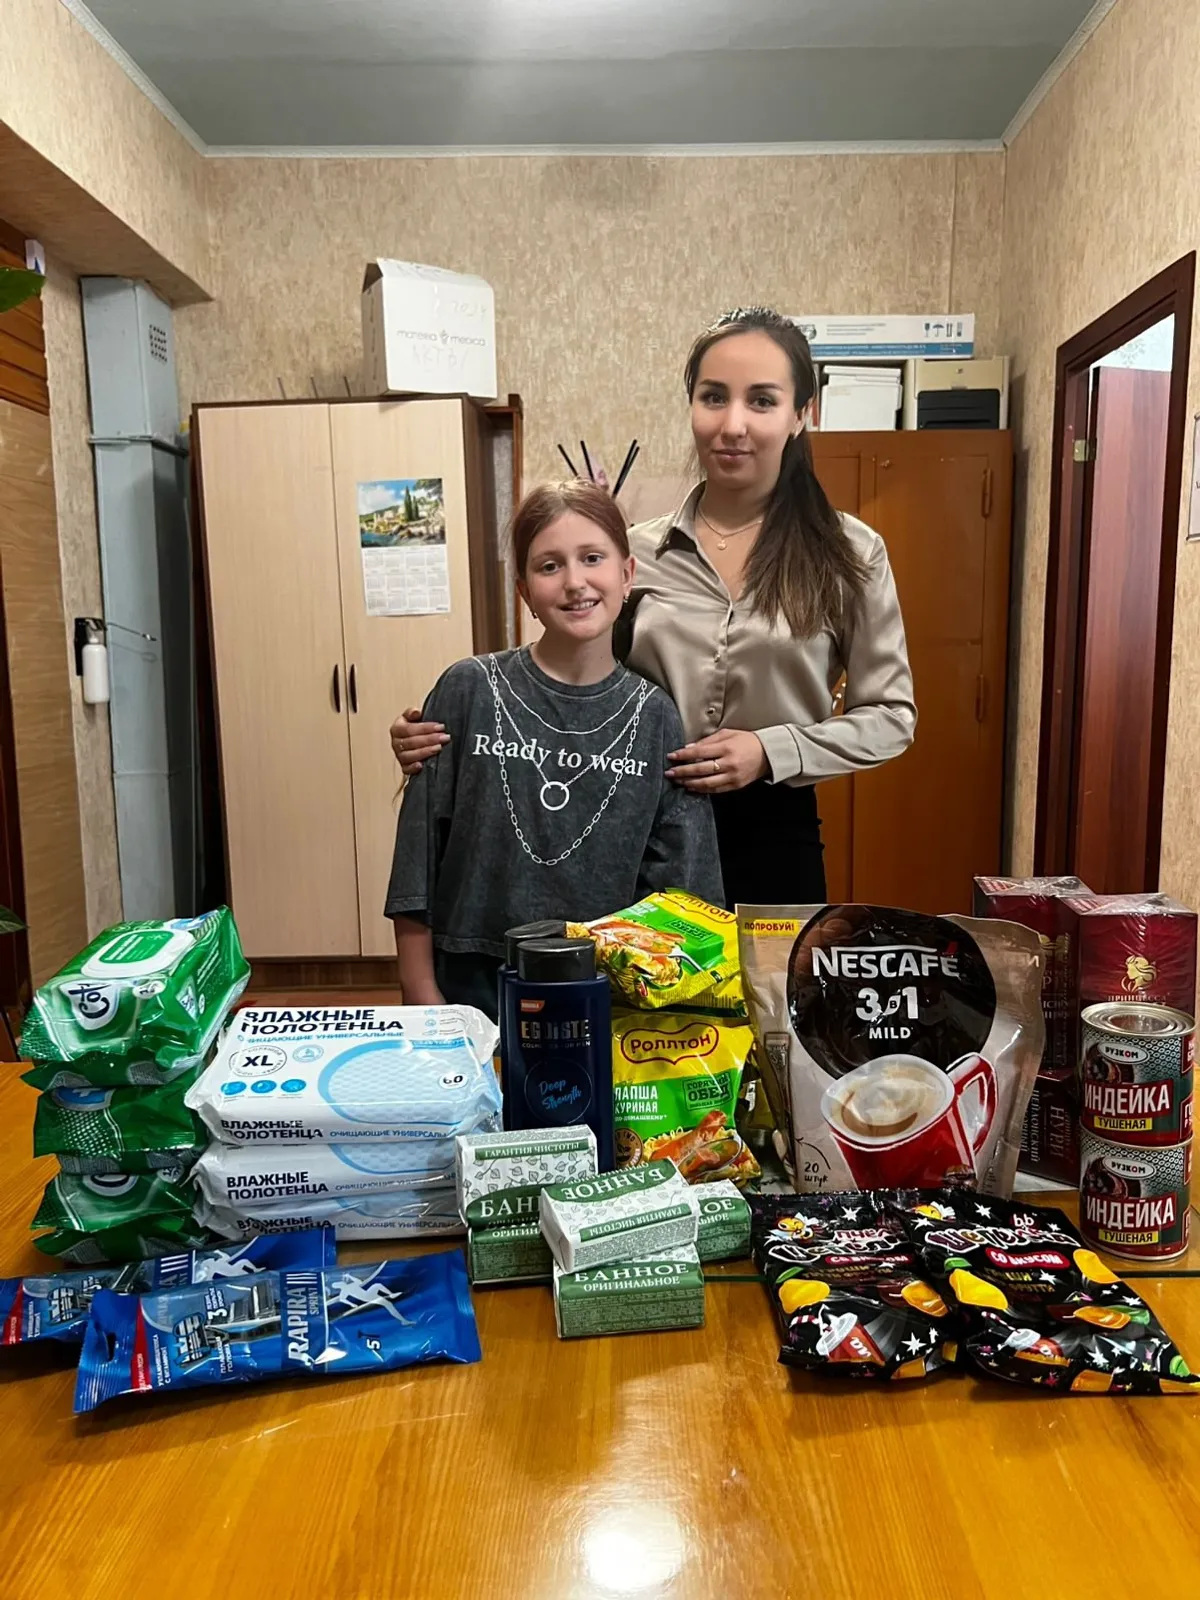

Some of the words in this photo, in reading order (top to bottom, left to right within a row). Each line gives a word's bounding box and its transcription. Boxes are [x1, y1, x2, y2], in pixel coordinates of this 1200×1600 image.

[472, 734, 551, 769] Ready
[557, 747, 582, 768] to
[590, 753, 648, 777] wear
[743, 921, 795, 932] ПОПРОБУЙ!
[855, 986, 883, 1021] 3
[901, 986, 919, 1020] 1
[244, 1009, 375, 1024] ВЛАЖНЫЕ
[240, 1020, 404, 1036] ПОЛОТЕНЦА
[868, 1027, 912, 1040] MILD
[242, 1055, 274, 1068] XL
[1104, 1046, 1139, 1060] РУЗКОМ
[538, 1078, 567, 1096] Deep
[614, 1085, 658, 1100] ЛАПША
[688, 1086, 730, 1102] ОБЕД
[541, 1083, 583, 1111] Strength
[1084, 1083, 1171, 1117] ИНДЕЙКА
[614, 1100, 659, 1114] КУРИНАЯ
[221, 1118, 304, 1130] ВЛАЖНЫЕ
[1049, 1106, 1065, 1158] НУРИ
[1097, 1117, 1147, 1130] ТУШЕНАЯ
[329, 1129, 391, 1138] ОЧИЩАЮЩИЕ
[484, 1146, 532, 1158] ГАРАНТИЯ
[535, 1141, 580, 1154] ЧИСТОТЫ
[803, 1162, 819, 1174] 20
[1110, 1161, 1147, 1174] РУЗКОМ
[226, 1171, 309, 1188] ВЛАЖНЫЕ
[560, 1167, 666, 1200] БАННОЕ
[227, 1182, 329, 1200] ПОЛОТЕНЦА
[637, 1205, 682, 1225] ГАРАНТИЯ
[1086, 1195, 1175, 1230] ИНДЕЙКА
[589, 1216, 636, 1236] ЧИСТОТЫ
[1103, 1230, 1153, 1243] ТУШЕНАЯ
[574, 1263, 690, 1283] БАННОЕ
[583, 1275, 681, 1293] ОРИГИНАЛЬНОЕ
[308, 1287, 320, 1316] SPRINT
[287, 1287, 310, 1364] RAPIRA
[366, 1339, 381, 1350] 5
